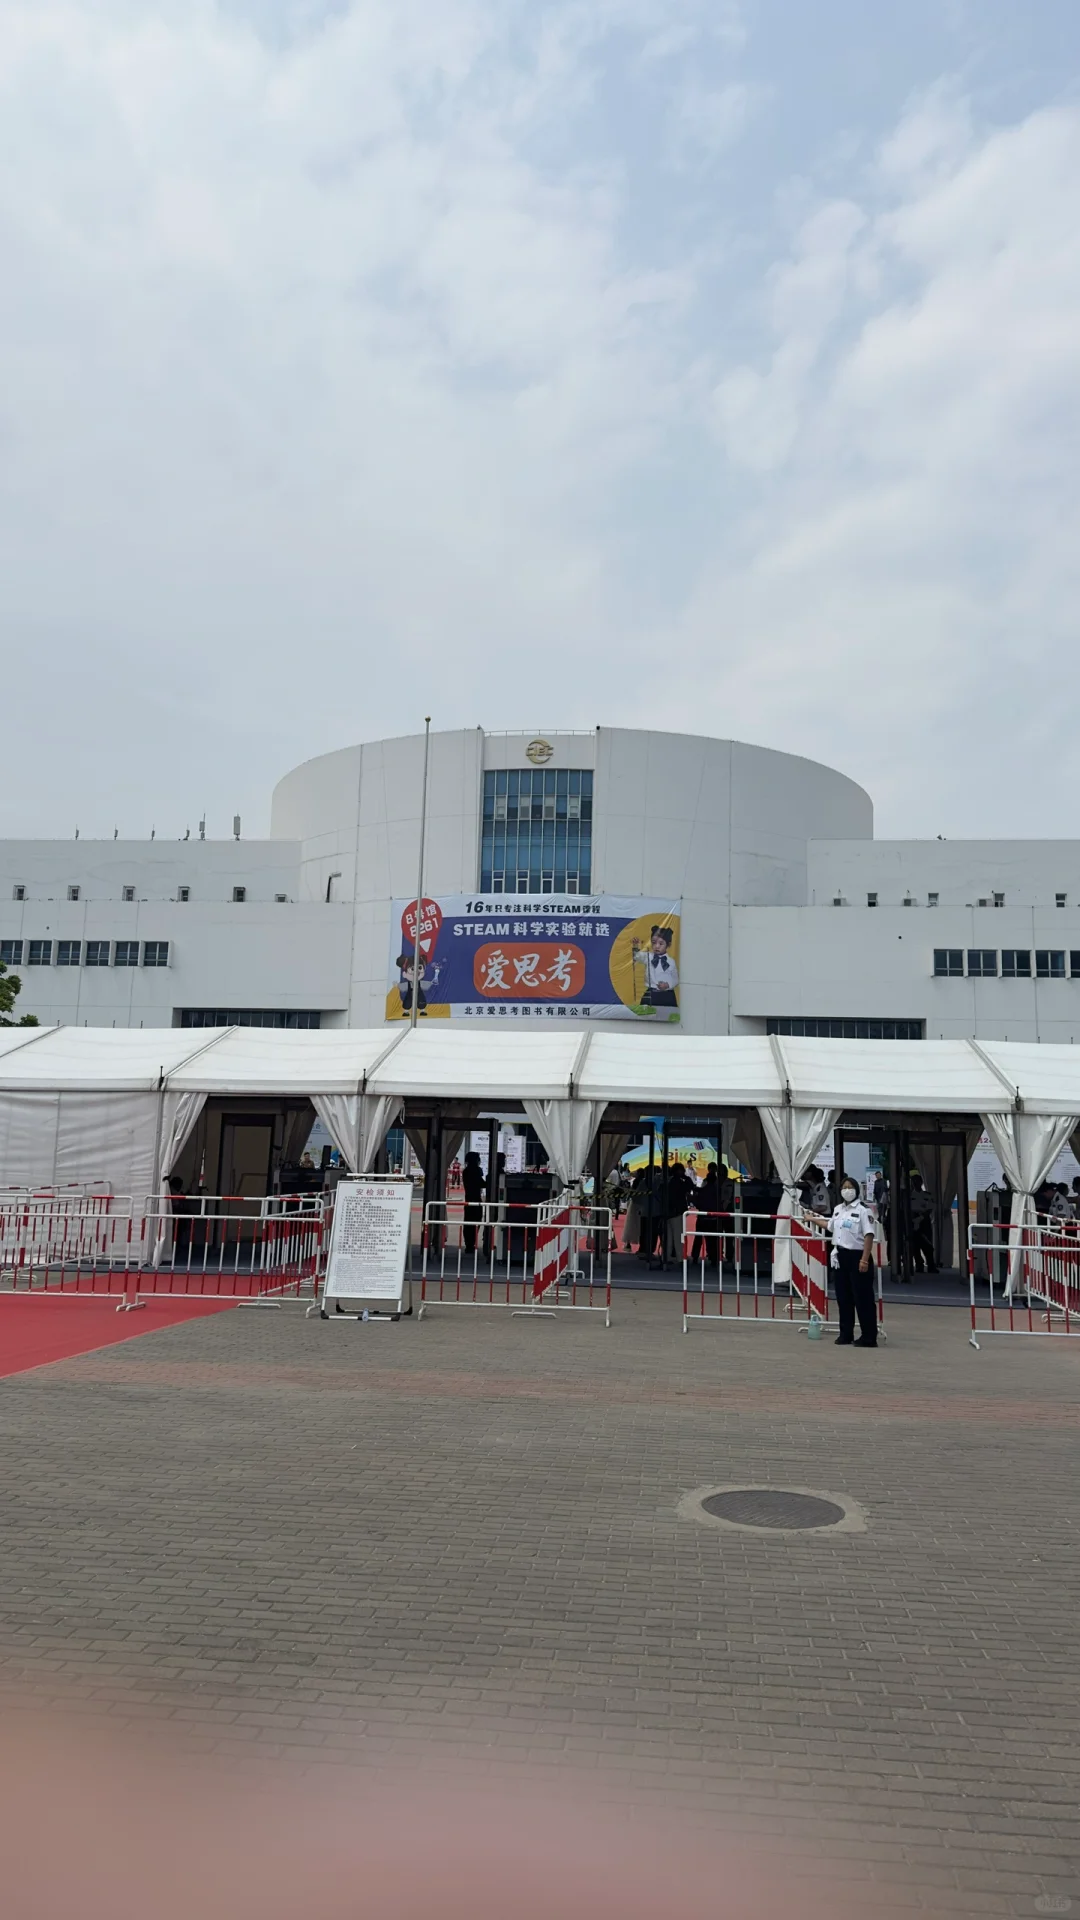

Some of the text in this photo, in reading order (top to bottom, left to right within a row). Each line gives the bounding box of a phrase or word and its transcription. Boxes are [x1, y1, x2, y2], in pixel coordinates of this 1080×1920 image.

[465, 901, 601, 915] 16年只专注科学STEAM课程
[409, 917, 439, 938] 8261
[453, 921, 610, 937] STEAM 科学实验就选
[480, 949, 578, 992] 爱思考
[464, 1006, 591, 1016] 北京爱思考图书有限公司
[356, 1188, 395, 1197] 安检须知
